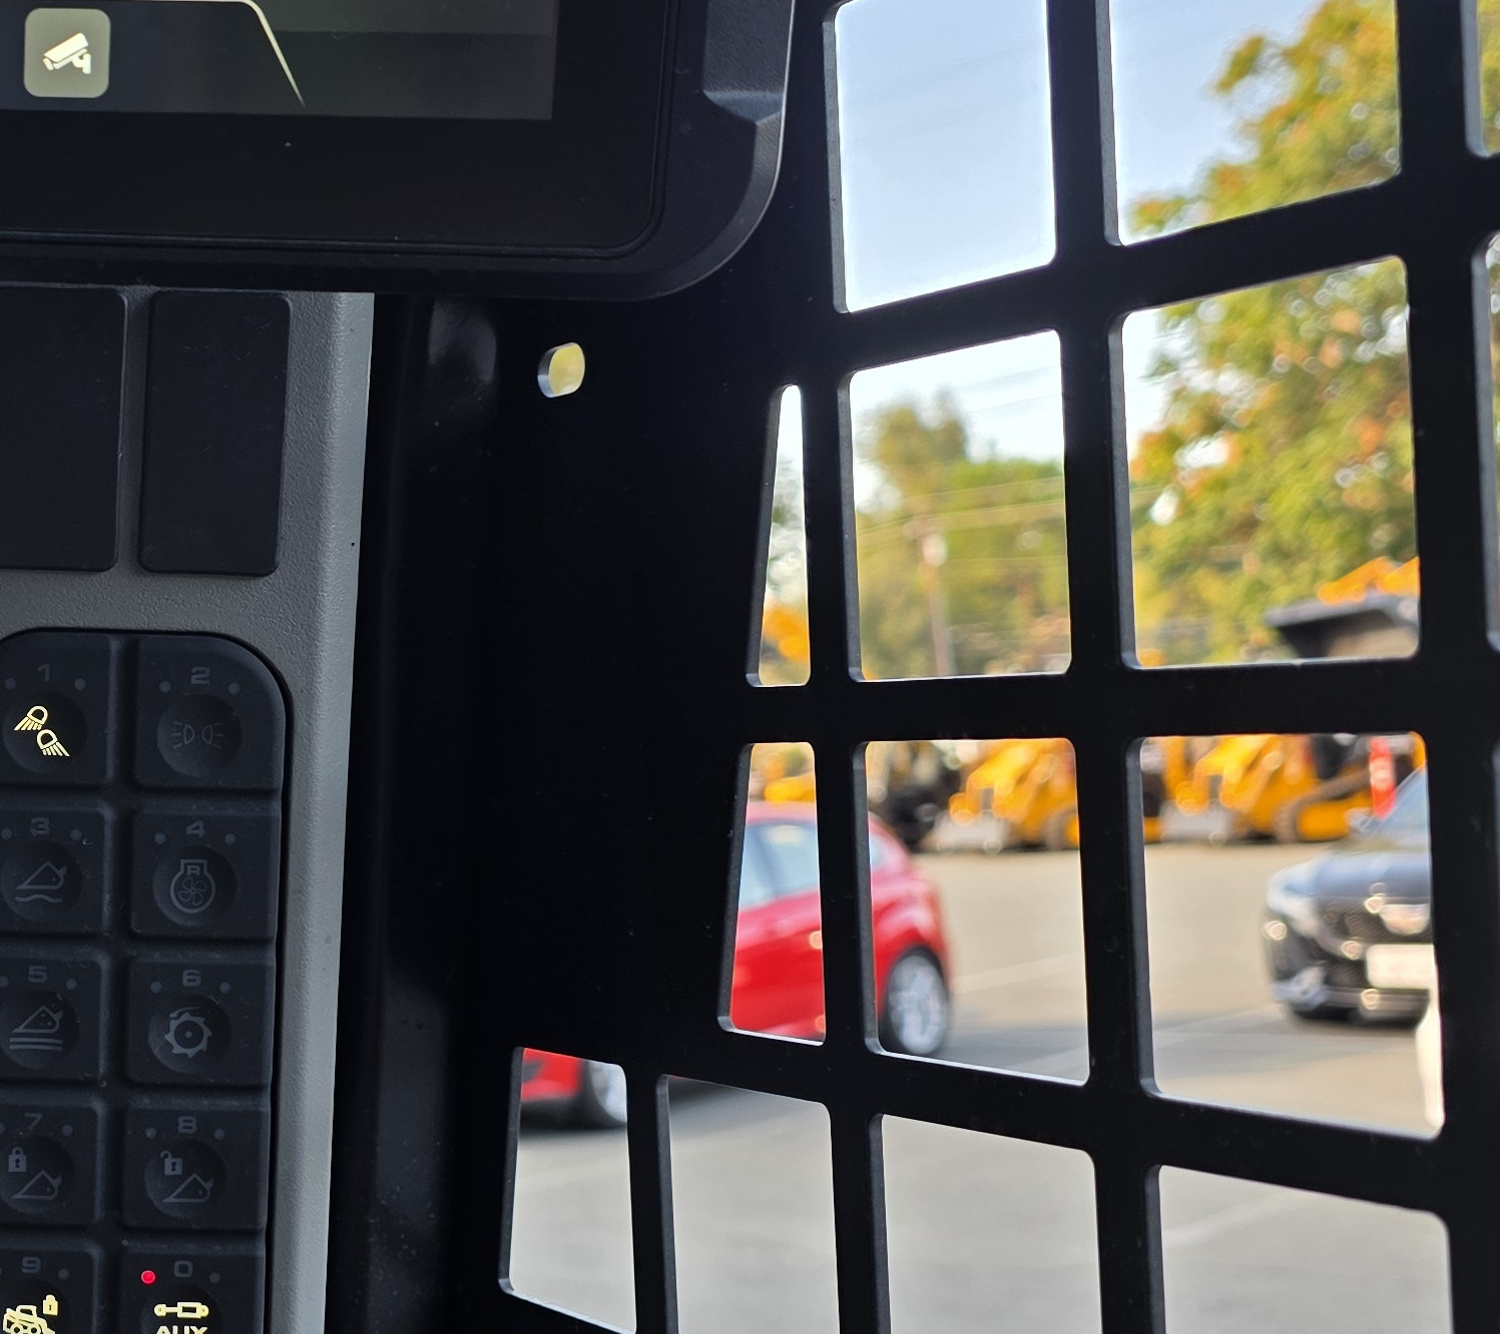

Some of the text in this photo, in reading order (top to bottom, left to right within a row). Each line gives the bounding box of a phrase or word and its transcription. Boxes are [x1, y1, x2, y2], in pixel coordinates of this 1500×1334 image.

[36, 664, 51, 681] 1
[191, 667, 209, 684] 2
[31, 818, 49, 836] 3
[187, 821, 205, 837] 4
[28, 966, 47, 983] 5
[183, 970, 200, 986] 6
[25, 1113, 42, 1130] 7
[178, 1116, 196, 1133] 8
[22, 1257, 40, 1273] 9
